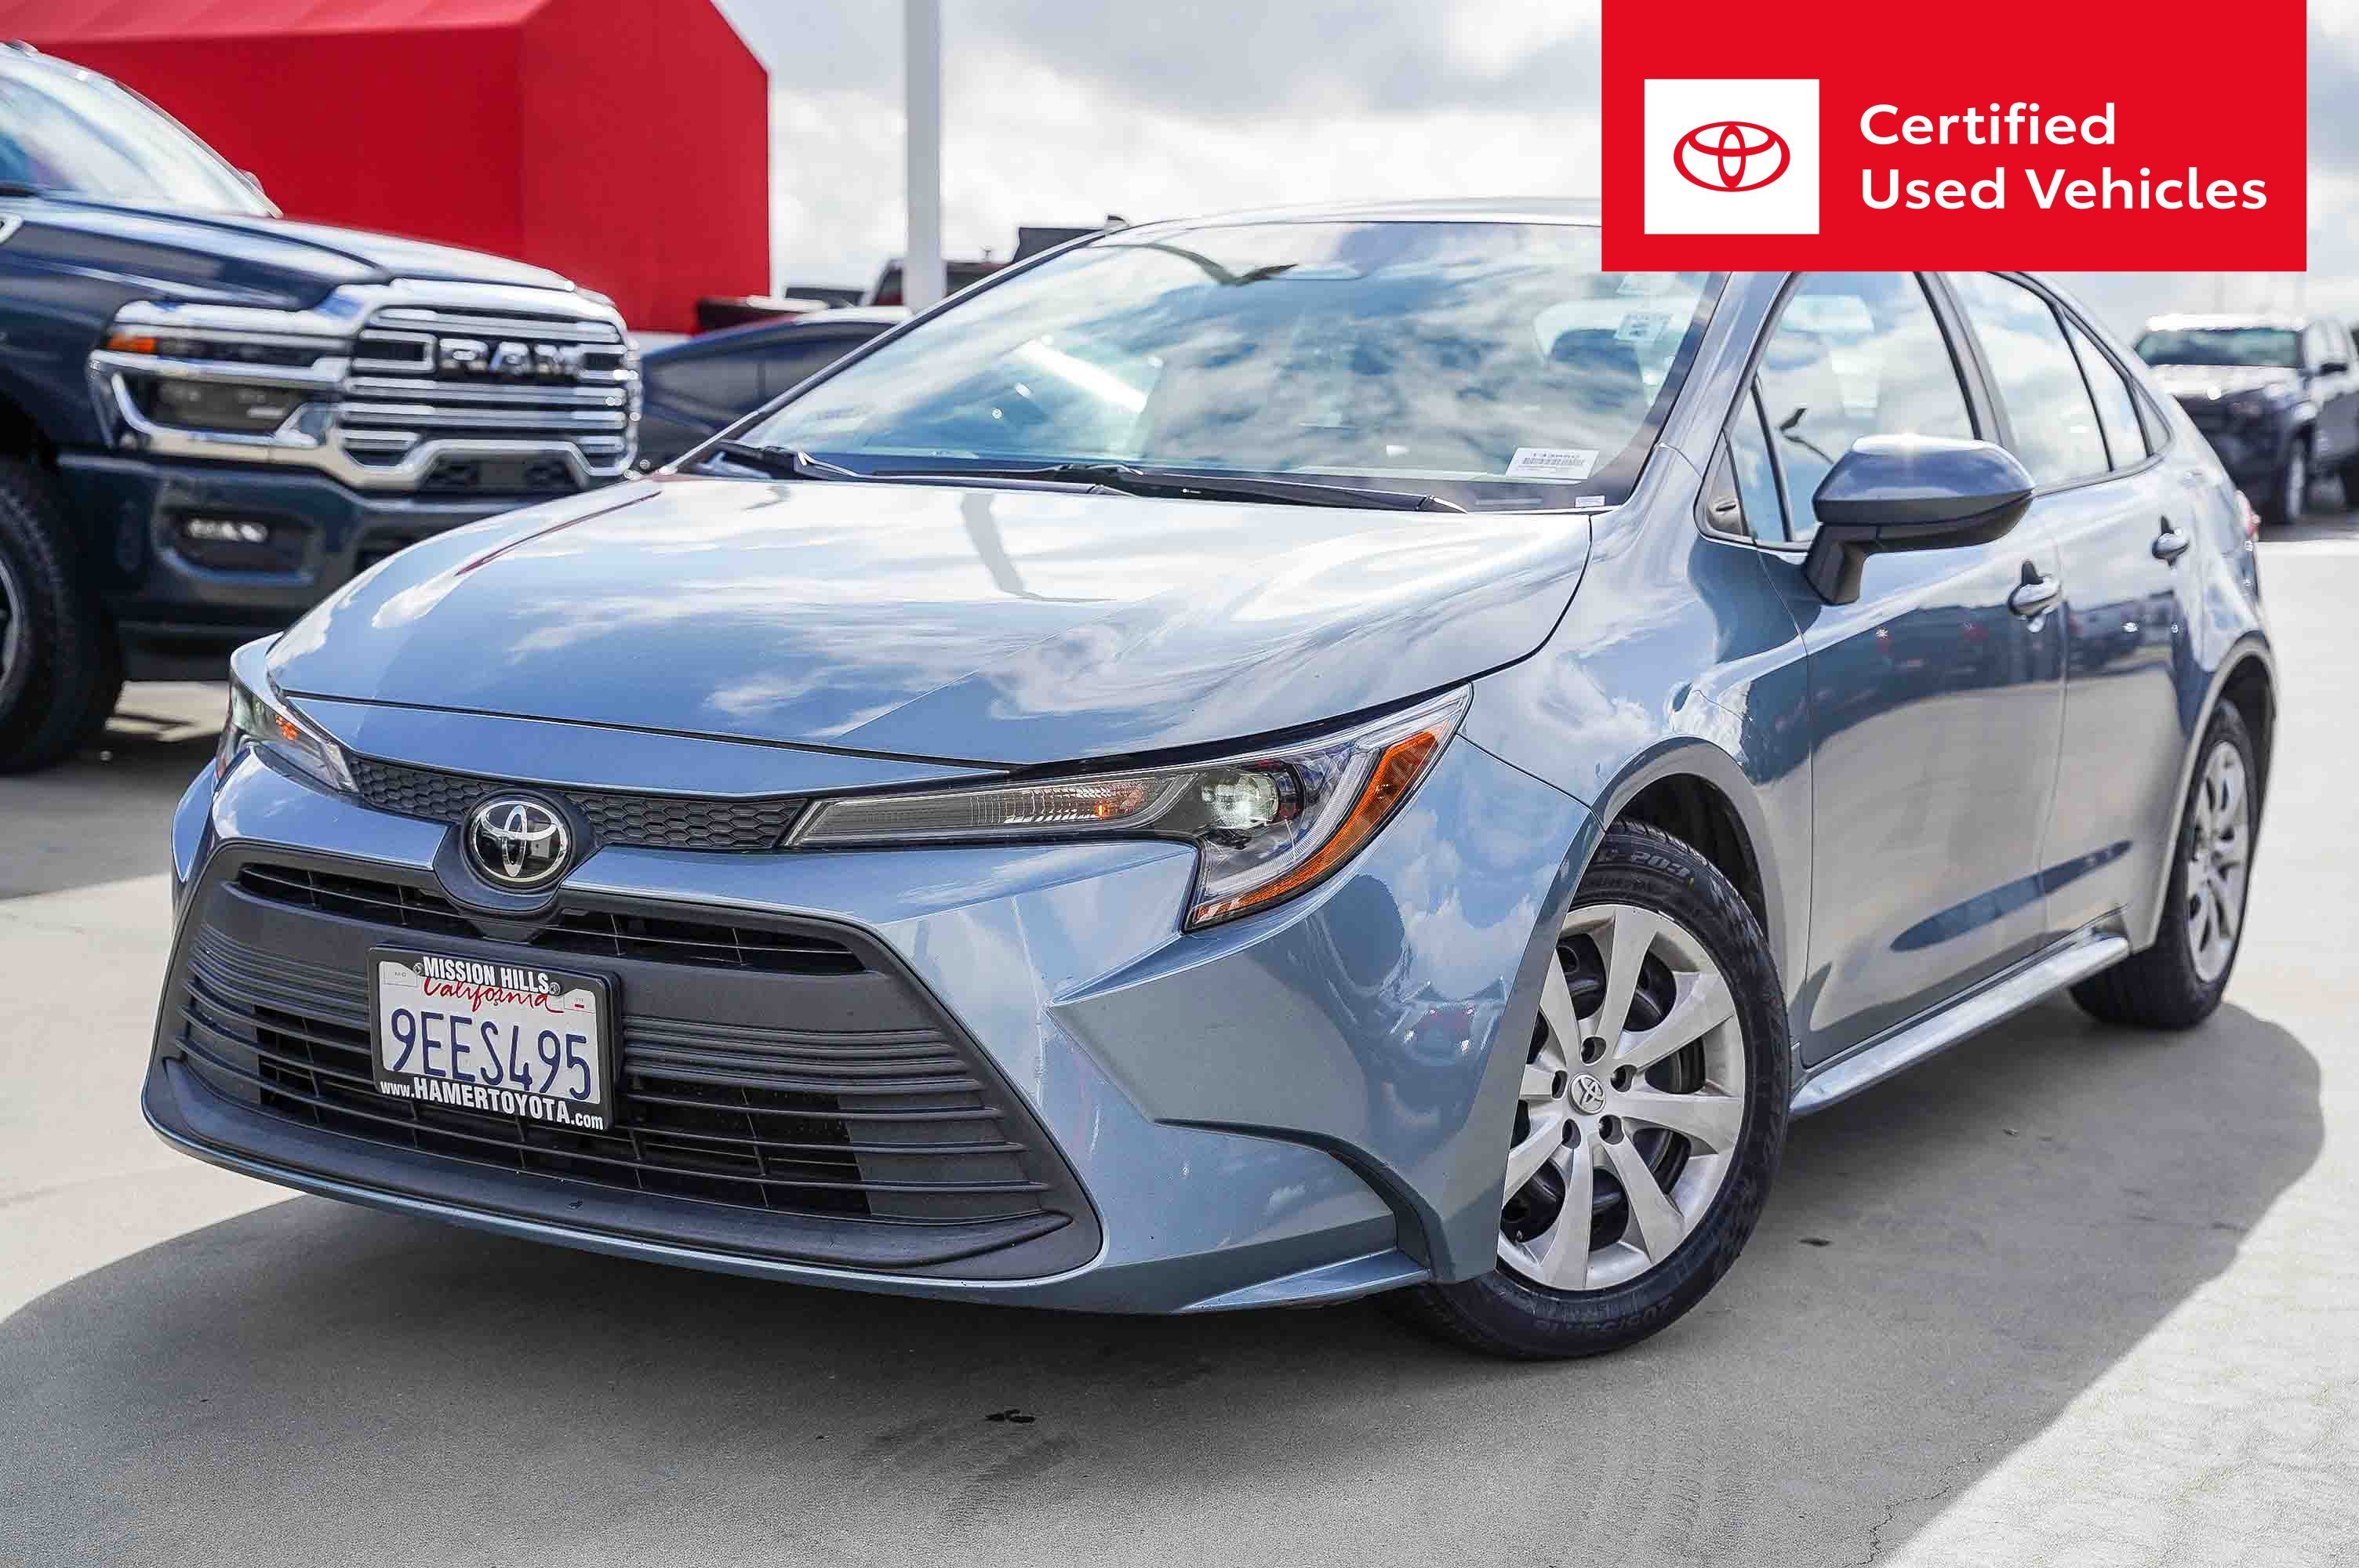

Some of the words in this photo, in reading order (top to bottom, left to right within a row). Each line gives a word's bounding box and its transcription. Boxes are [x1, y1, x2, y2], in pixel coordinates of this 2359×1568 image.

[438, 338, 582, 376] RAM
[423, 956, 495, 985] MISSION
[500, 967, 549, 993] HILLS
[423, 978, 564, 1012] California
[391, 1007, 591, 1100] 9EES495
[380, 1076, 604, 1131] www.HAMERTOYOTA.com
